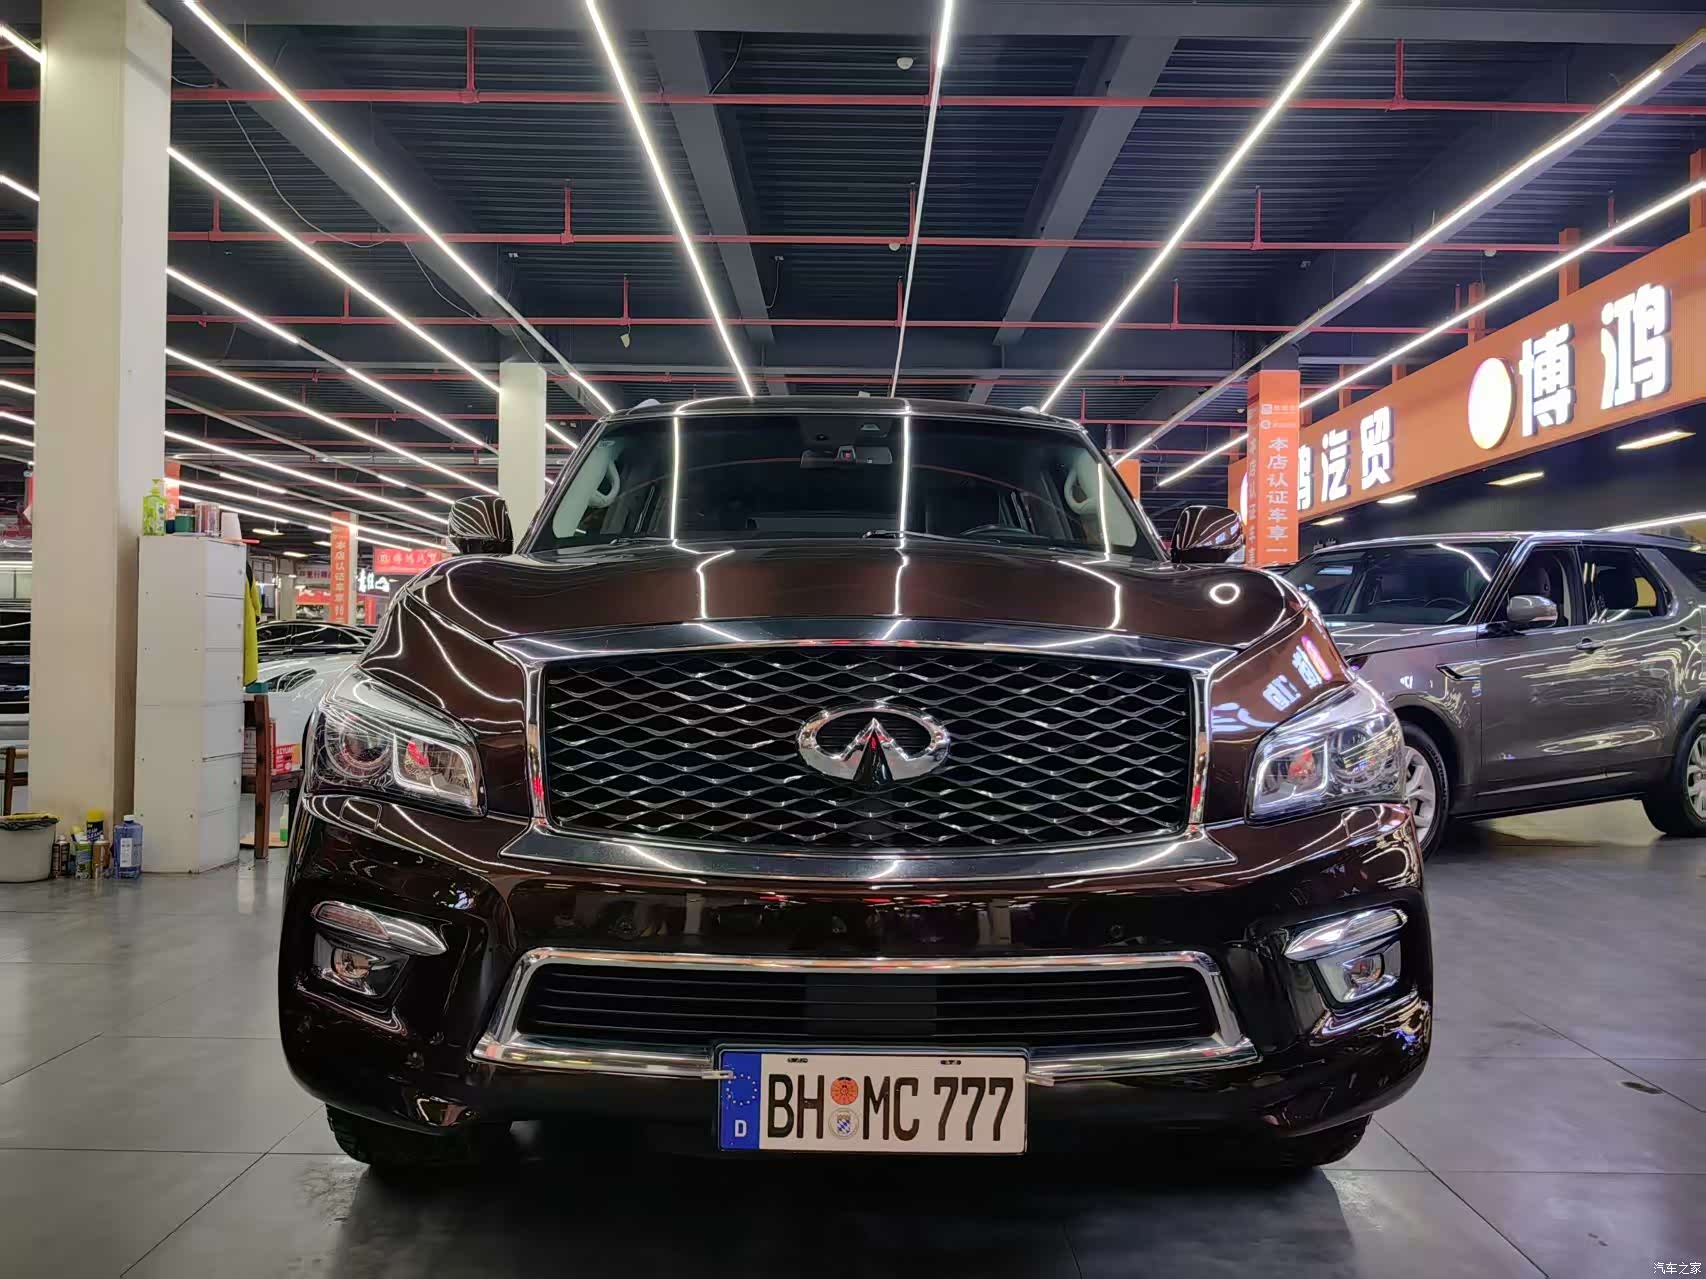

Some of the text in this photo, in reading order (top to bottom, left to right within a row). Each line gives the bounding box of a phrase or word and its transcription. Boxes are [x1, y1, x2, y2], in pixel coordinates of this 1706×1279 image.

[1519, 283, 1670, 437] 博鸿
[734, 1073, 1014, 1142] D BH MC 777
